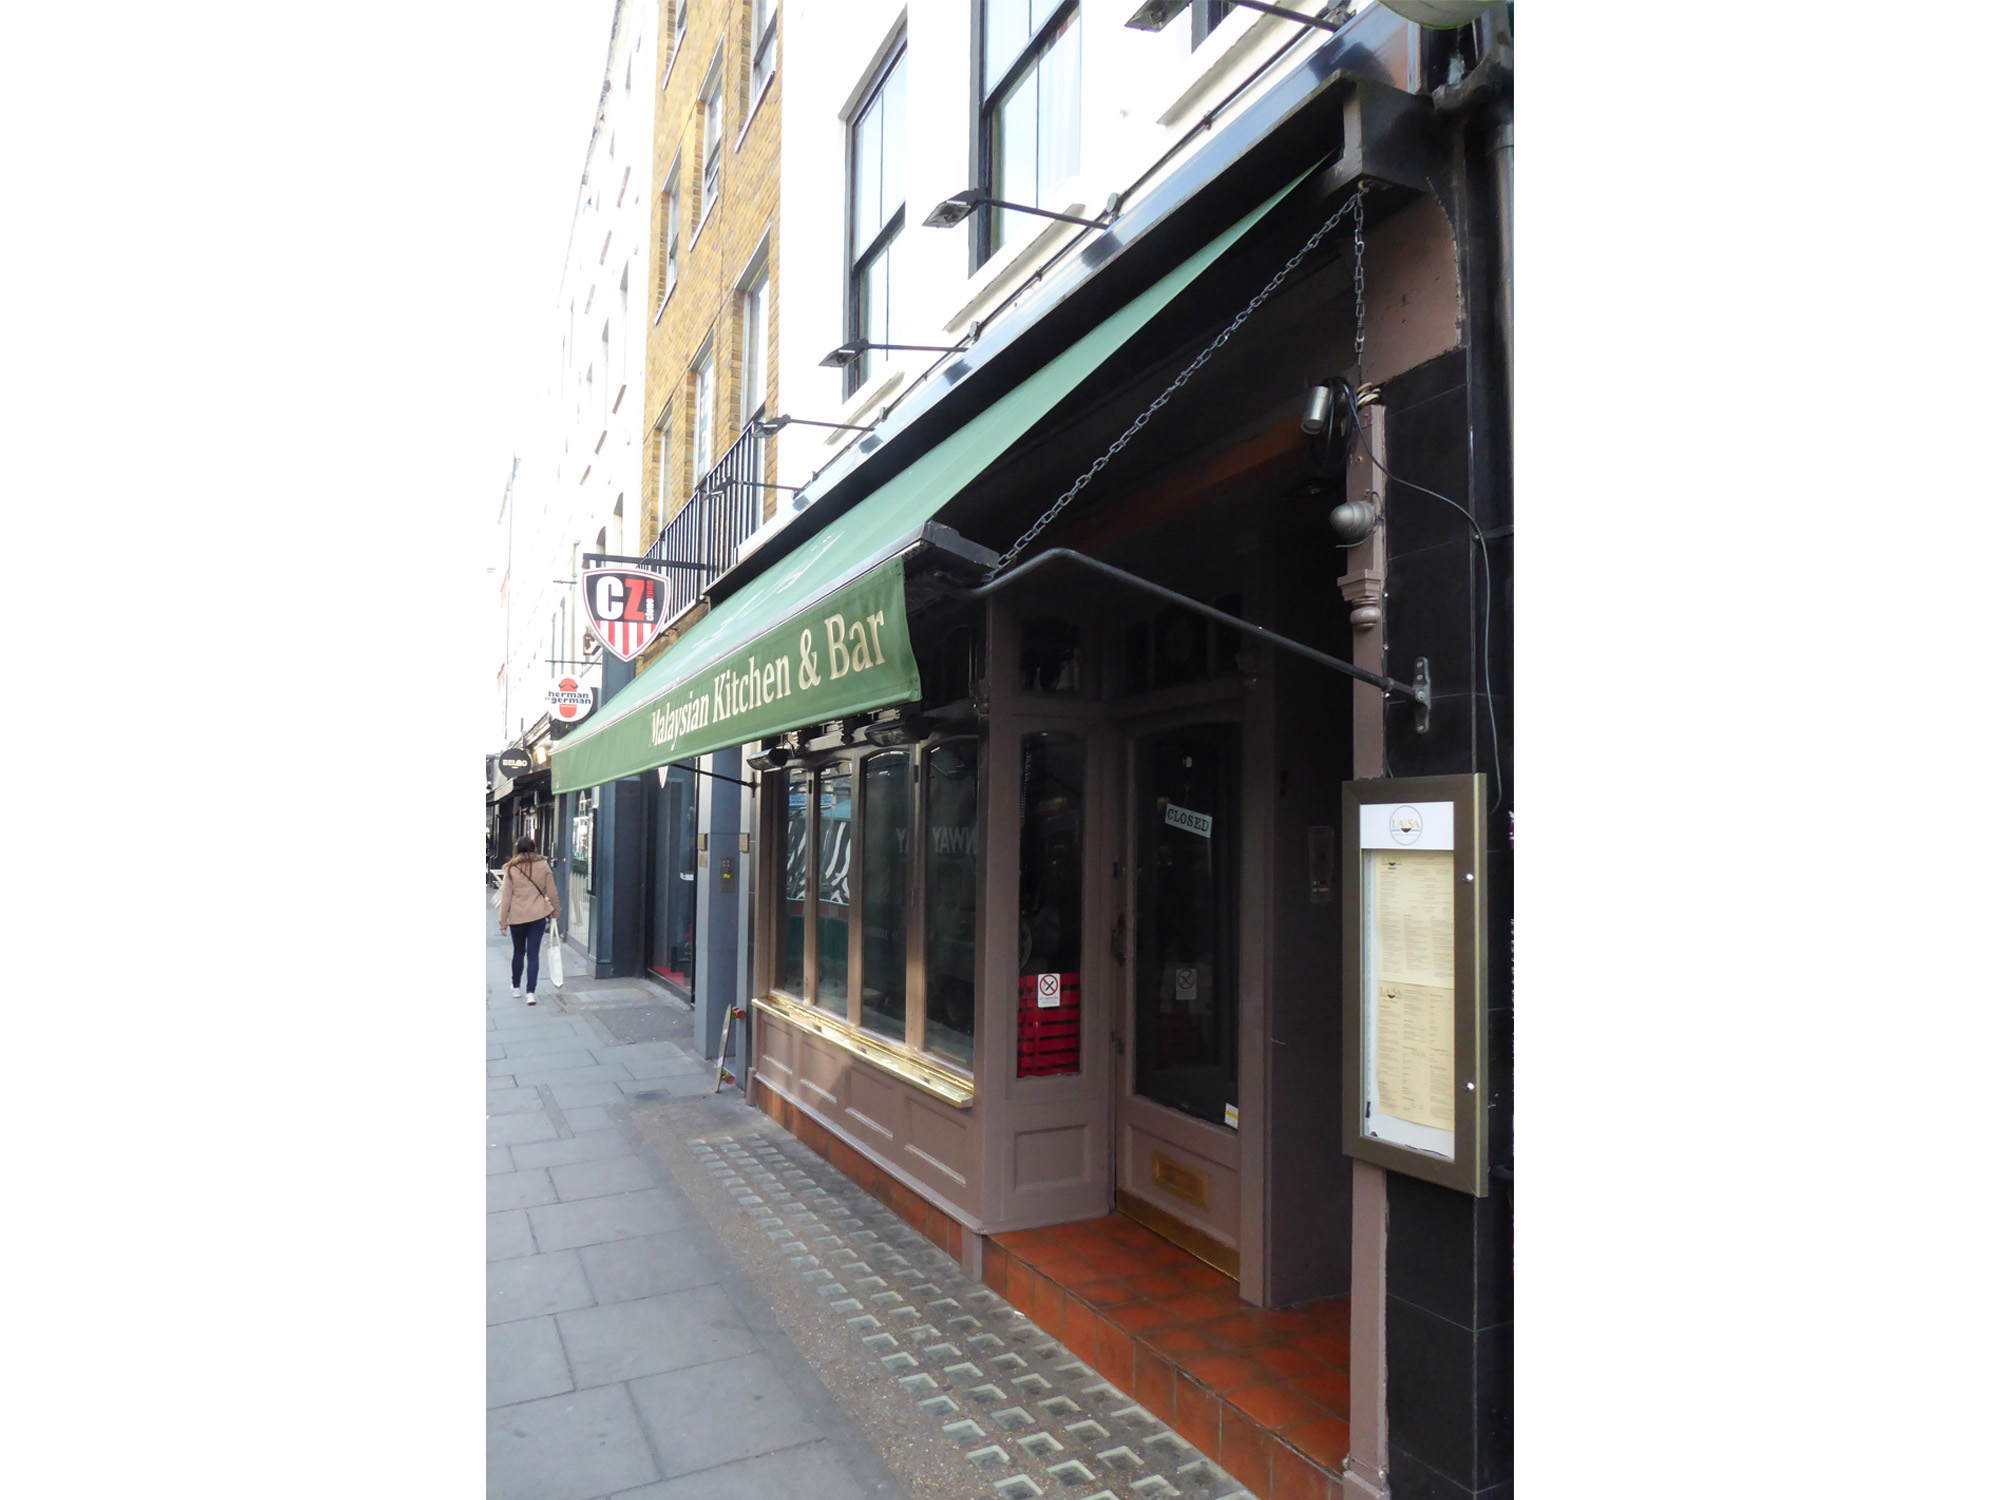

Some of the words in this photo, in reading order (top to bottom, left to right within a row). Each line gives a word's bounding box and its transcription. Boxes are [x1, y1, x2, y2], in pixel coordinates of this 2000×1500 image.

[596, 575, 645, 621] CZ
[548, 690, 589, 699] herman
[650, 690, 709, 751] Malaysian
[712, 655, 791, 723] Kitchen
[798, 628, 822, 690] &
[824, 610, 886, 681] Bar
[1167, 808, 1210, 832] CLOSED
